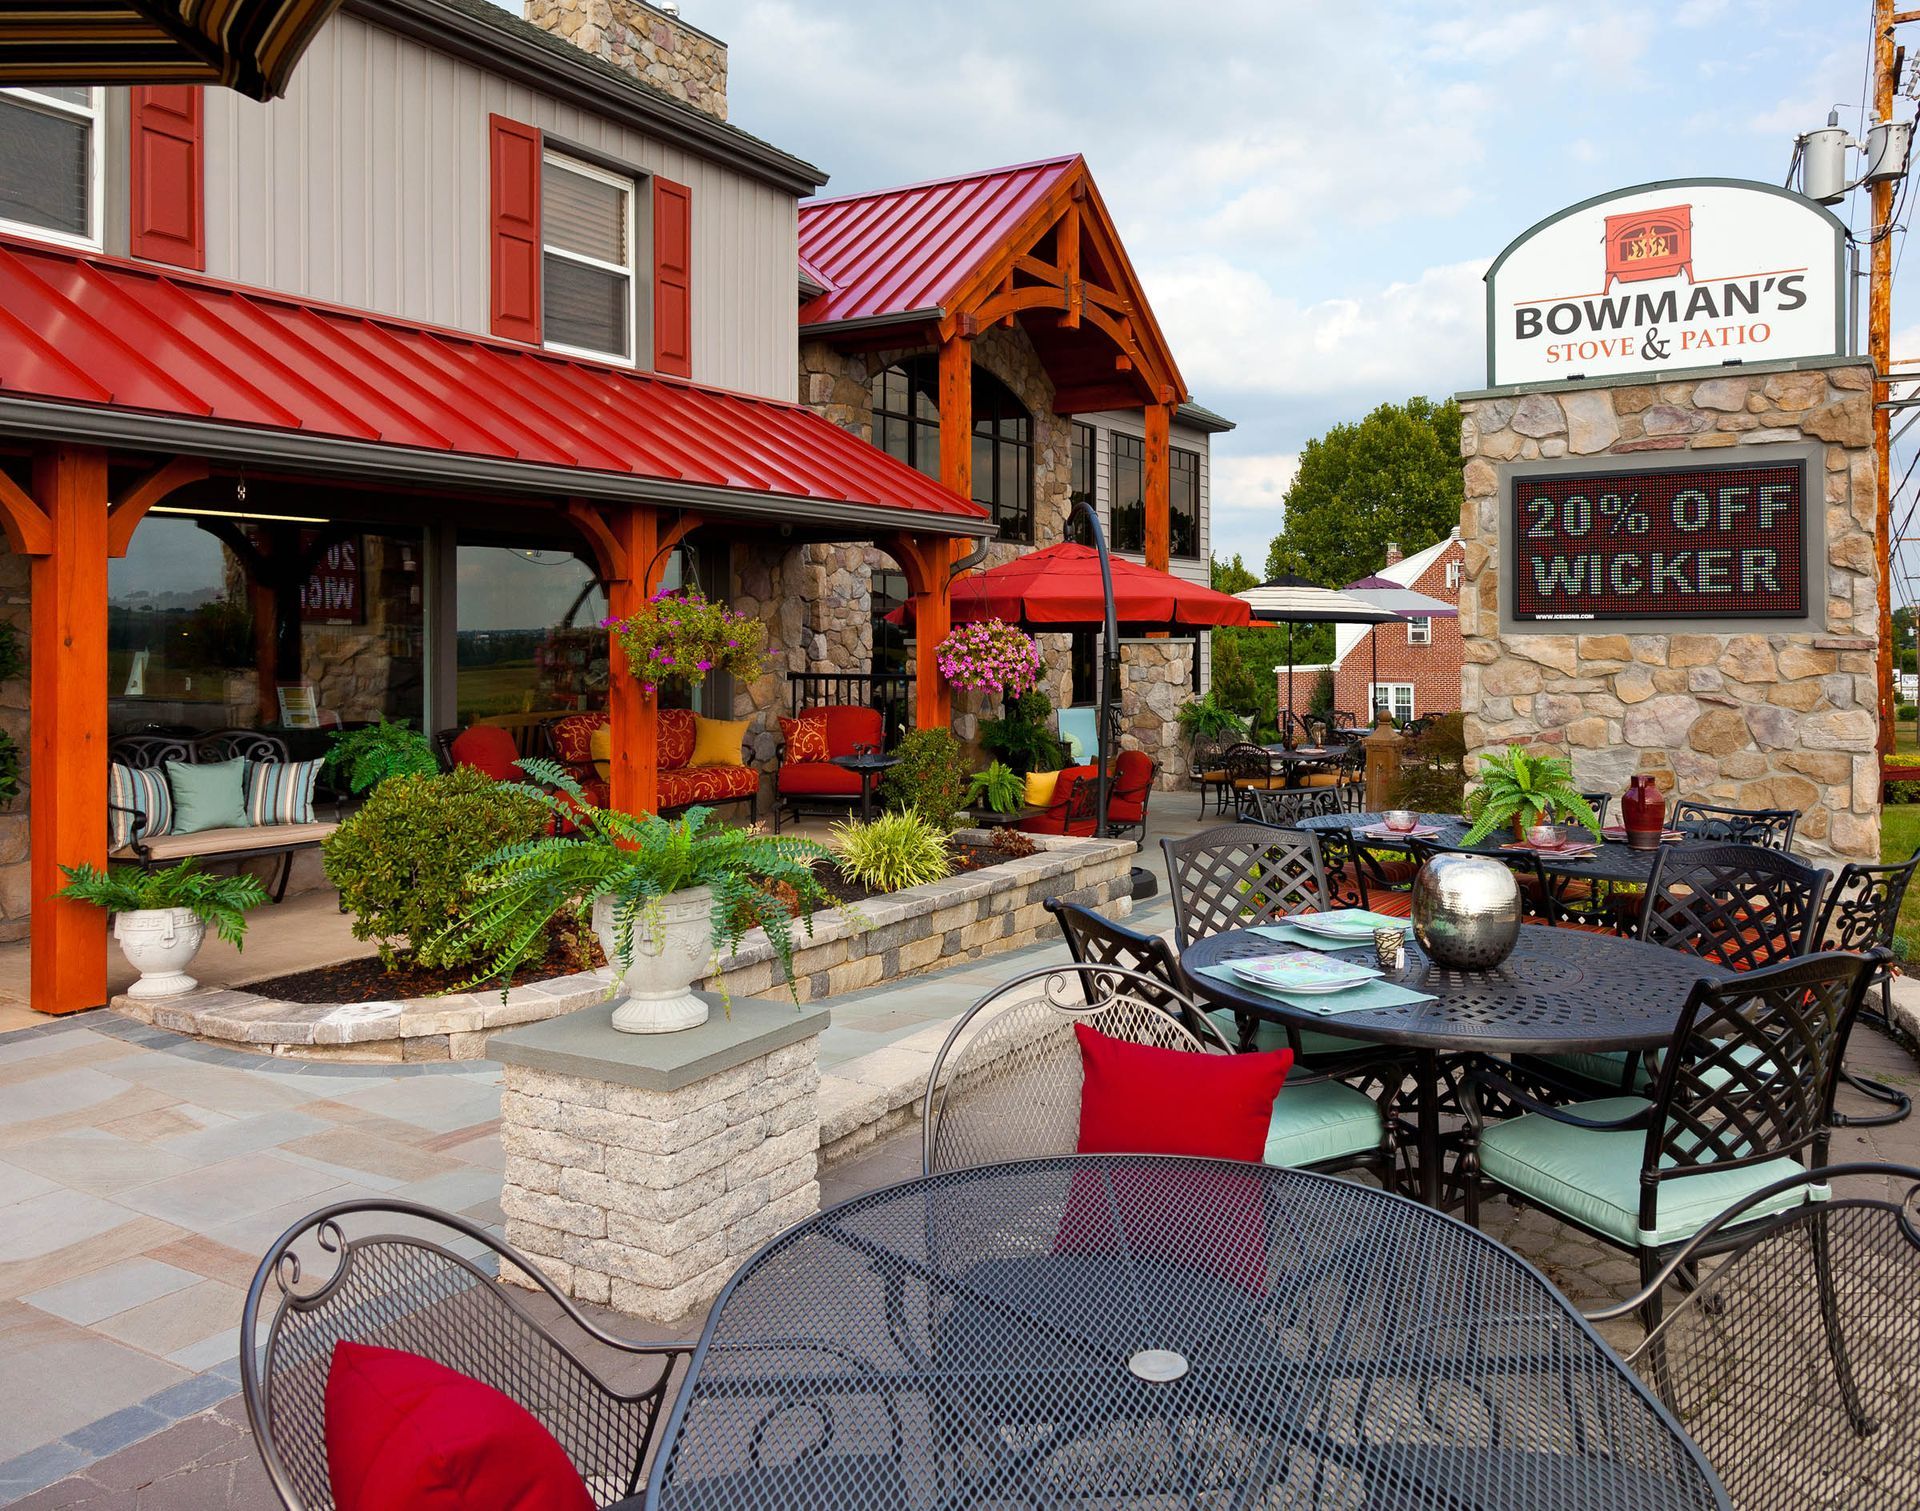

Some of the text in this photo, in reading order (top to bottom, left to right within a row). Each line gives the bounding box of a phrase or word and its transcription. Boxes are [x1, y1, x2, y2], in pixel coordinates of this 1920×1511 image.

[1515, 274, 1808, 341] BOWMAN'S
[1546, 322, 1771, 364] STOVE & PATIO
[1527, 485, 1792, 538] 20% OFF
[1531, 549, 1781, 596] WICKER
